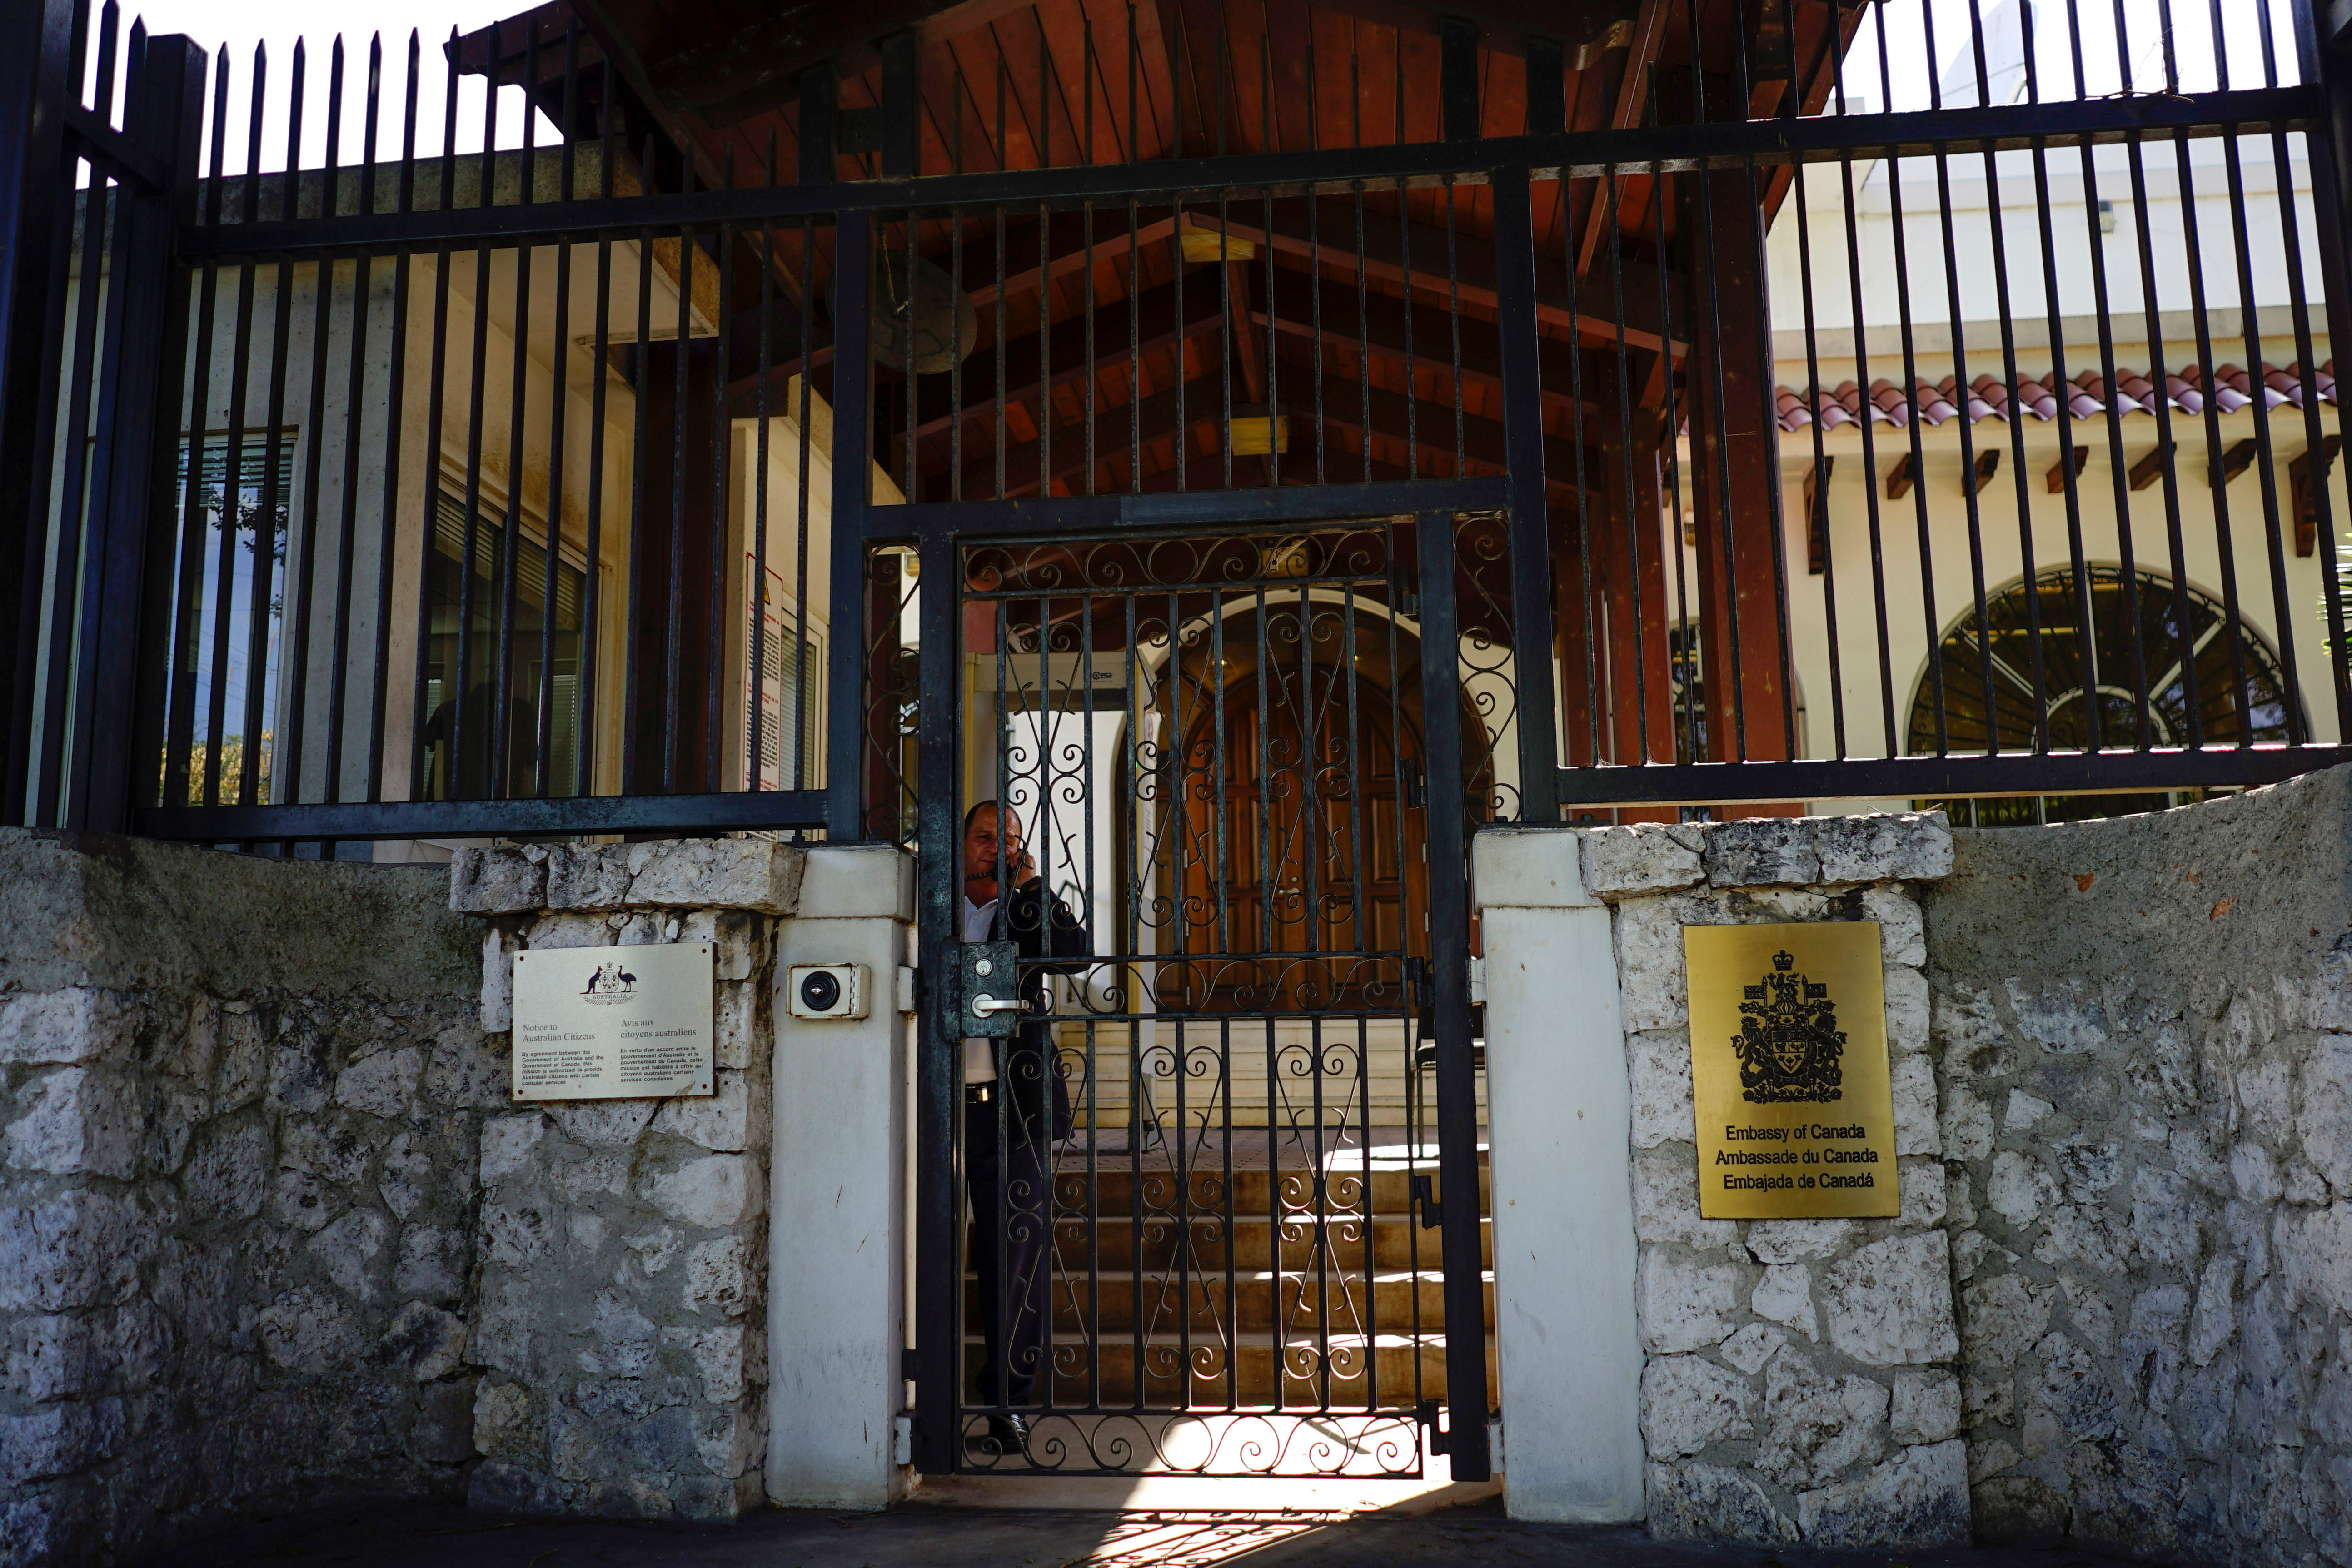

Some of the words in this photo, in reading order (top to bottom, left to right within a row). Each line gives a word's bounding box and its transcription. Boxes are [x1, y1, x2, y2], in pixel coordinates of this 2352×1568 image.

[523, 1023, 548, 1032] Notice
[621, 1019, 638, 1027] Avis
[523, 1033, 562, 1042] Australian
[564, 1032, 595, 1040] Citizens
[620, 1030, 653, 1040] citoyens
[655, 1028, 697, 1037] australiens
[1726, 1125, 1789, 1143] Embassy
[1794, 1124, 1807, 1140] of
[1811, 1123, 1866, 1140] Canada
[1715, 1149, 1798, 1165] Ambassade
[1802, 1149, 1820, 1164] du
[1824, 1147, 1878, 1164] Canada
[1724, 1174, 1794, 1193] Embajada
[1798, 1173, 1816, 1189] de
[1819, 1172, 1874, 1188] Canadá
